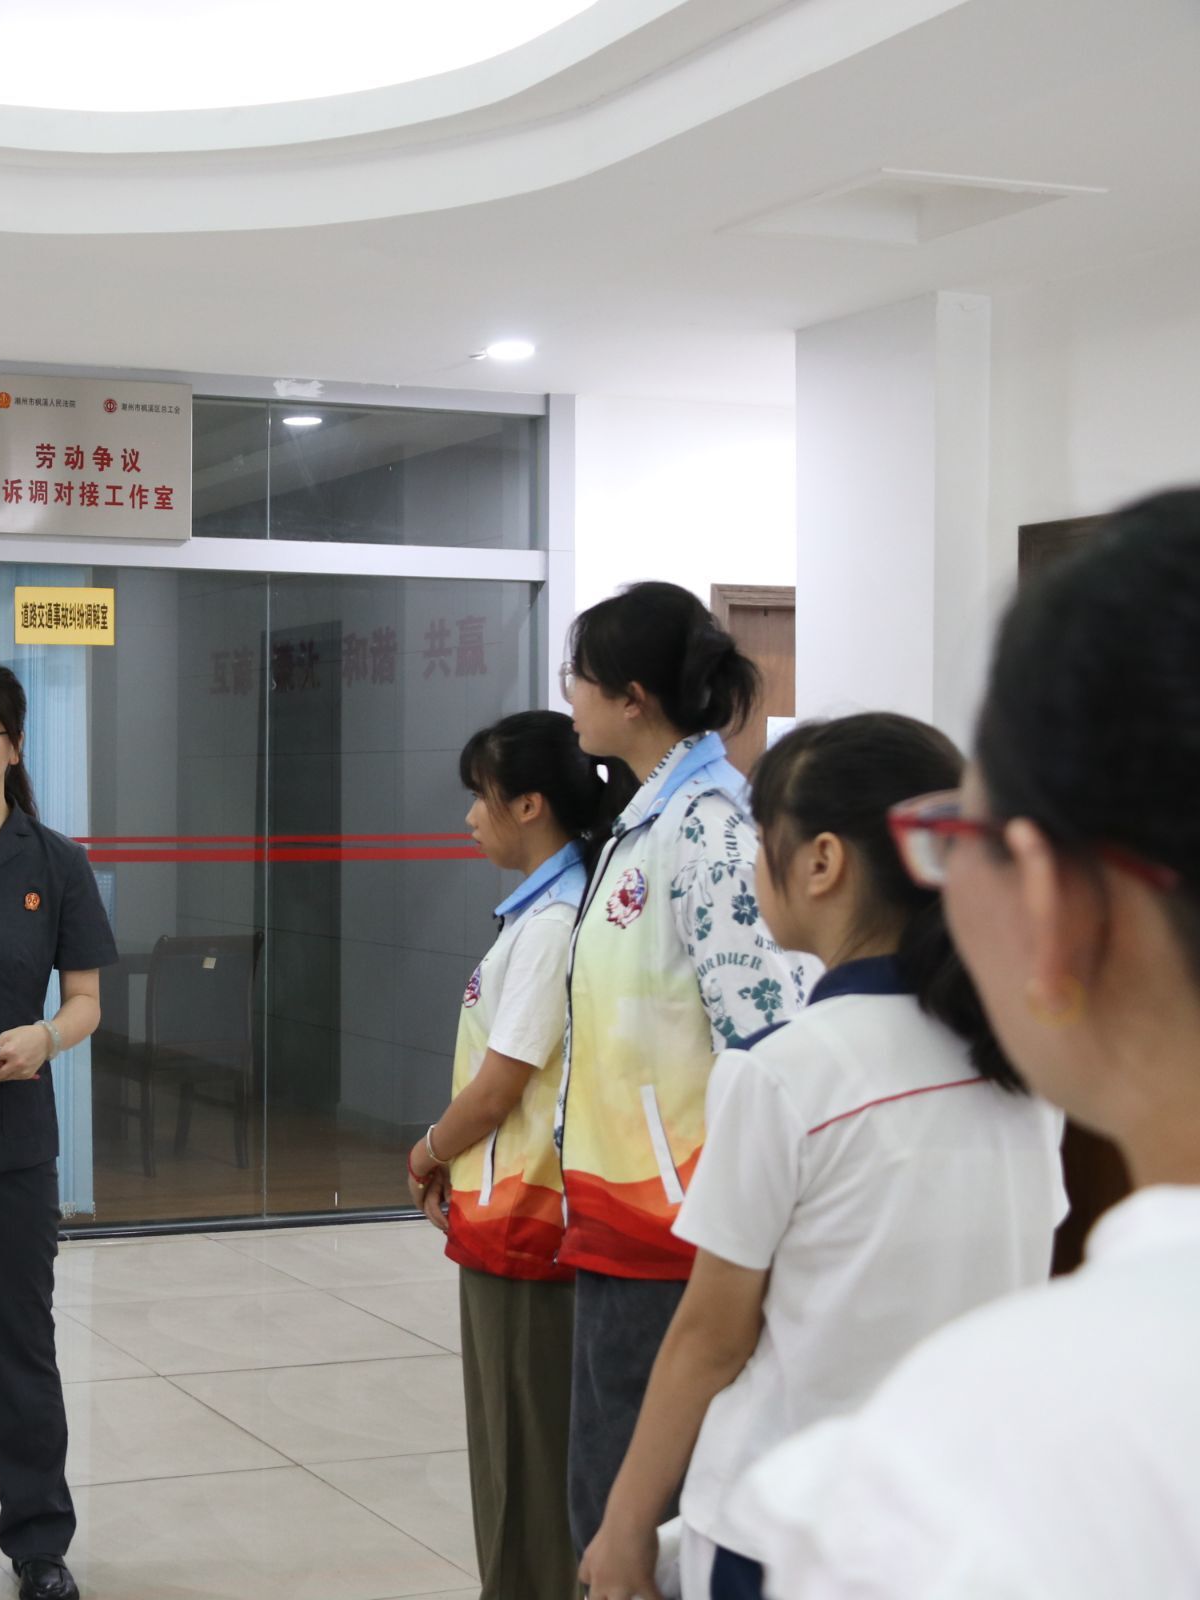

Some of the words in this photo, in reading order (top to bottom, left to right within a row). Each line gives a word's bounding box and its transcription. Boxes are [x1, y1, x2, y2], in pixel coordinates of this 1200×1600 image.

[35, 443, 142, 473] 劳动争议
[2, 478, 175, 511] 诉调对接工作室
[21, 602, 108, 630] 道路交通事故纠纷调解室
[422, 615, 488, 680] 共赢
